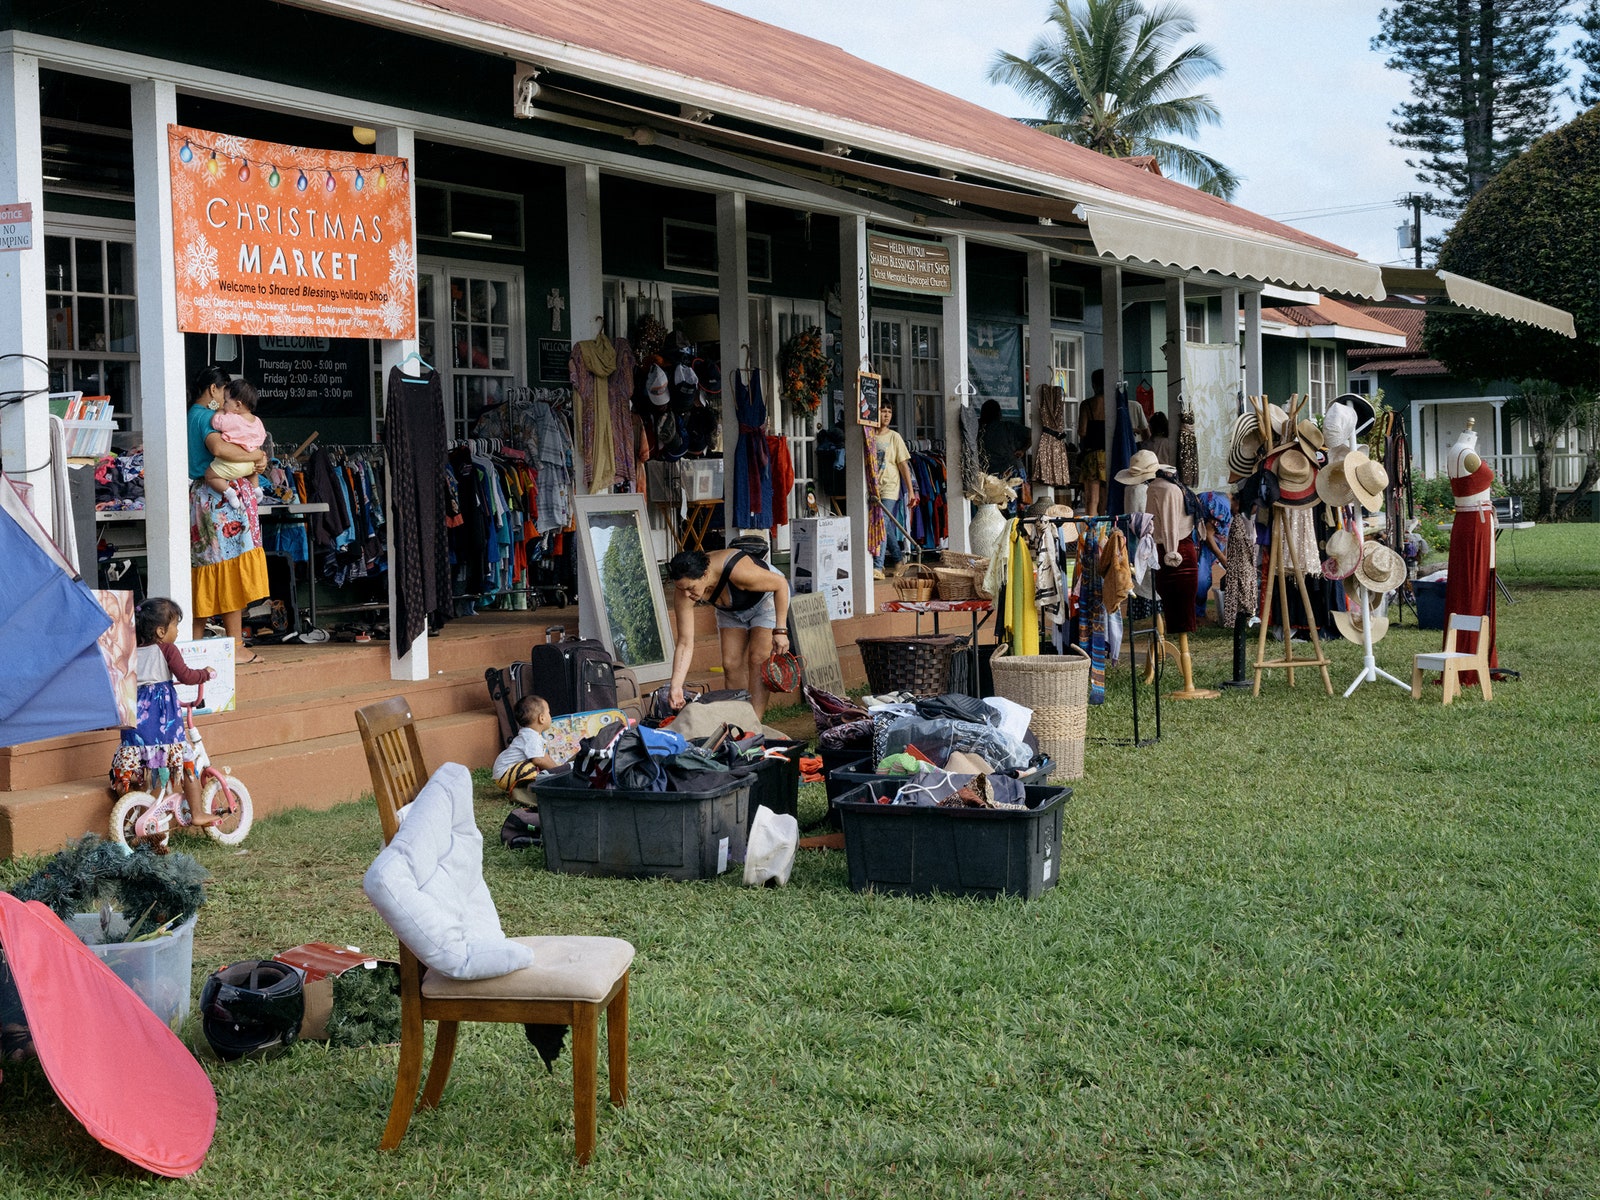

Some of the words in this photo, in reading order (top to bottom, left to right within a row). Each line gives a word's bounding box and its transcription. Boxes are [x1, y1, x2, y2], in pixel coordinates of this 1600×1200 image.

[0, 210, 22, 219] OTICE
[206, 197, 383, 243] CHRISTMAS
[3, 224, 15, 234] NO
[0, 235, 28, 247] MPING
[888, 242, 906, 255] HELEN
[238, 244, 358, 281] MARKET
[870, 251, 889, 267] SHARED
[889, 256, 915, 271] BLESSINGS
[915, 260, 935, 274] THRIFT
[934, 262, 950, 275] SHOP
[873, 268, 886, 280] Christ
[886, 271, 907, 283] Memorial
[907, 274, 930, 287] Episcopal
[929, 277, 947, 287] Church
[219, 280, 256, 293] Welcome
[258, 284, 267, 294] to
[269, 284, 300, 297] Shared
[302, 286, 340, 301] Blessings
[339, 289, 368, 303] Holiday
[369, 291, 389, 303] Shop
[255, 301, 290, 312] Stockings,
[214, 310, 241, 323] Holiday
[337, 318, 352, 326] and
[353, 317, 369, 328] Toys
[264, 336, 324, 349] WELCOME
[258, 358, 292, 371] Thursday
[294, 360, 312, 370] 2:00
[319, 360, 333, 370] 5:00
[334, 362, 347, 372] pm
[263, 373, 288, 386] Friday
[289, 374, 308, 384] 2:00
[313, 374, 328, 384] 5:00
[329, 376, 342, 386] pm
[256, 387, 288, 400] aturday
[289, 388, 305, 398] 9:30
[306, 390, 318, 398] am
[324, 388, 341, 398] 3:00
[342, 389, 353, 400] pm
[812, 595, 825, 611] LOVE
[807, 669, 816, 686] IS
[815, 664, 835, 683] WHO
[834, 663, 840, 678] I
